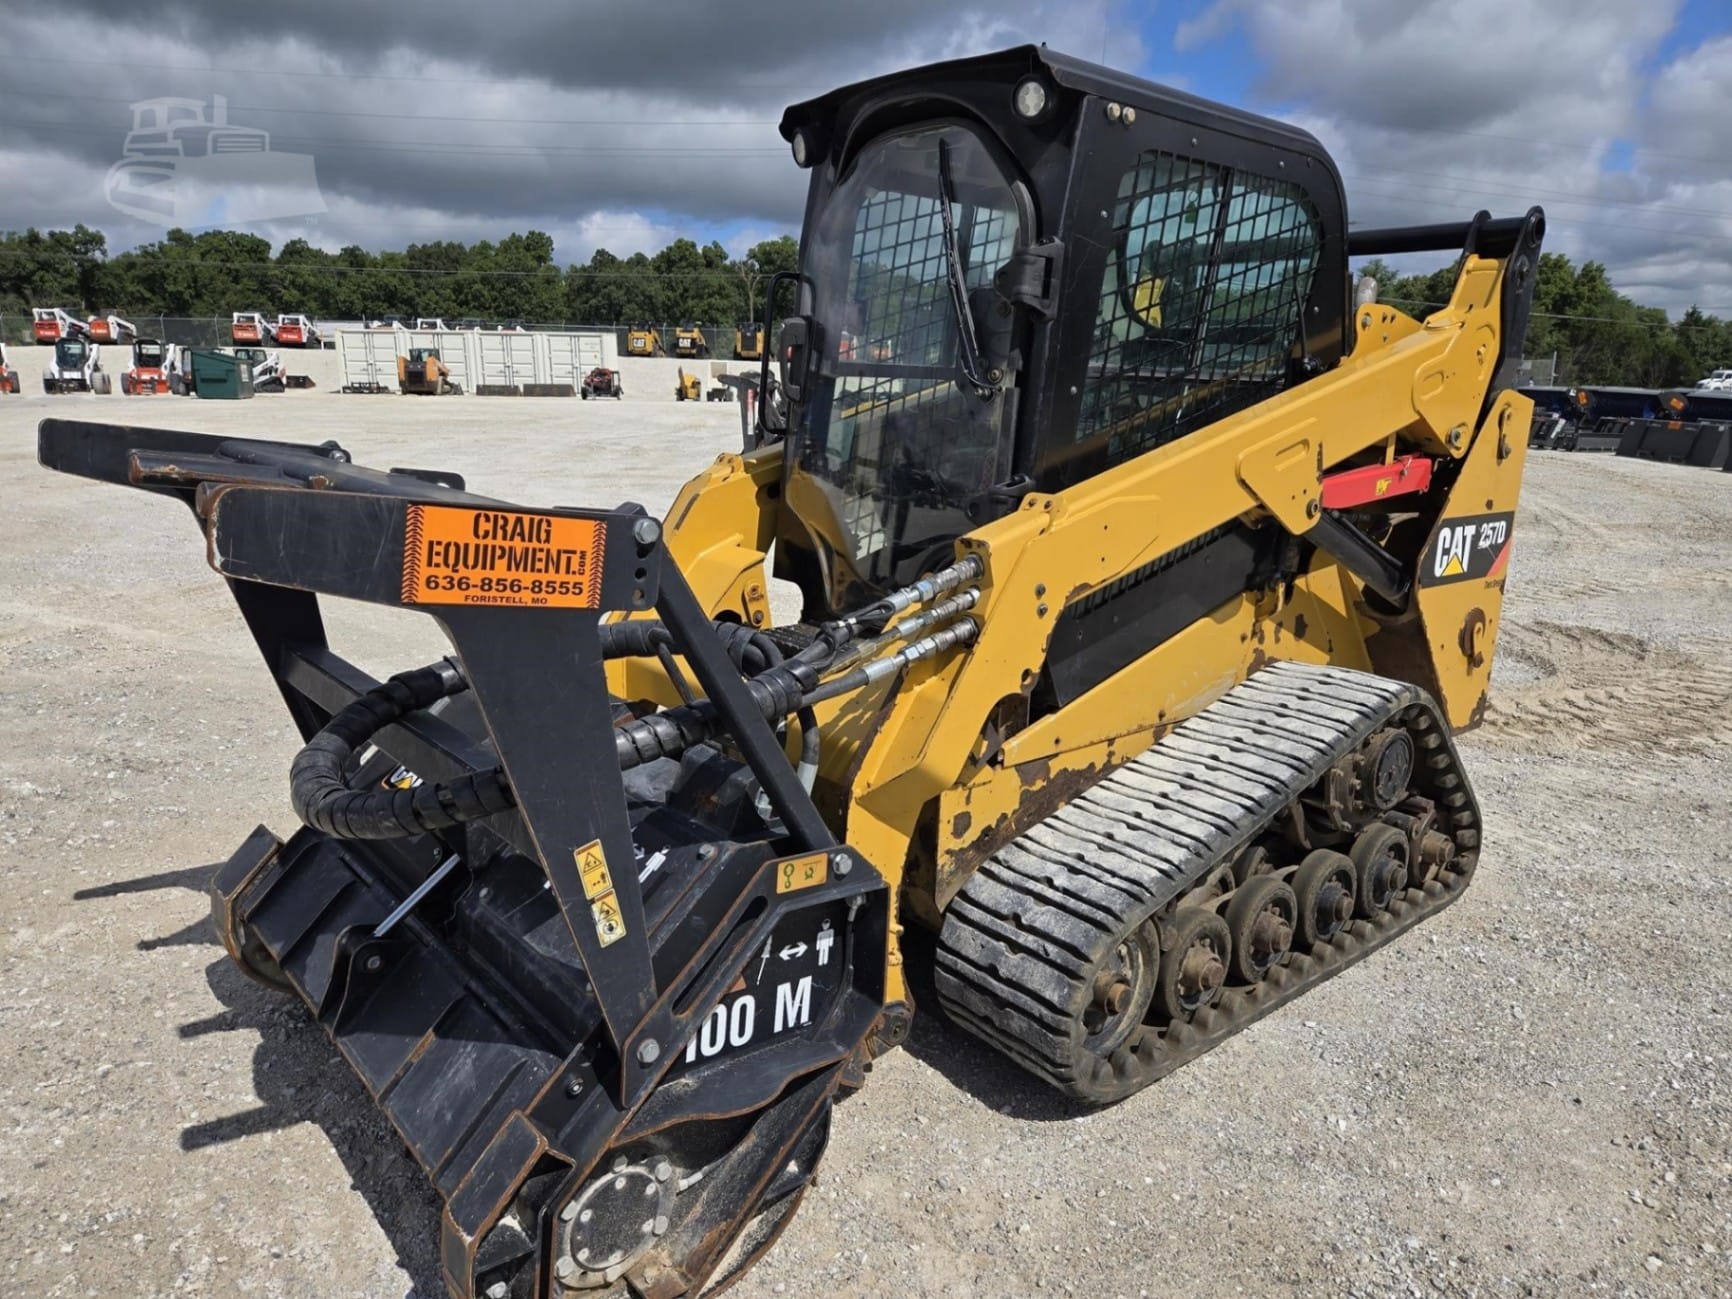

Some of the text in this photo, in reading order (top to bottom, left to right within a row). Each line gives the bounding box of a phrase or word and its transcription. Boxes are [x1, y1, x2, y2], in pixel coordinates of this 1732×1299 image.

[473, 512, 552, 544] CRAIG
[1434, 520, 1507, 578] CAT 257D
[425, 575, 584, 596] 636-856-8555
[464, 594, 548, 605] FORISTELL, MO
[773, 975, 813, 1034] M
